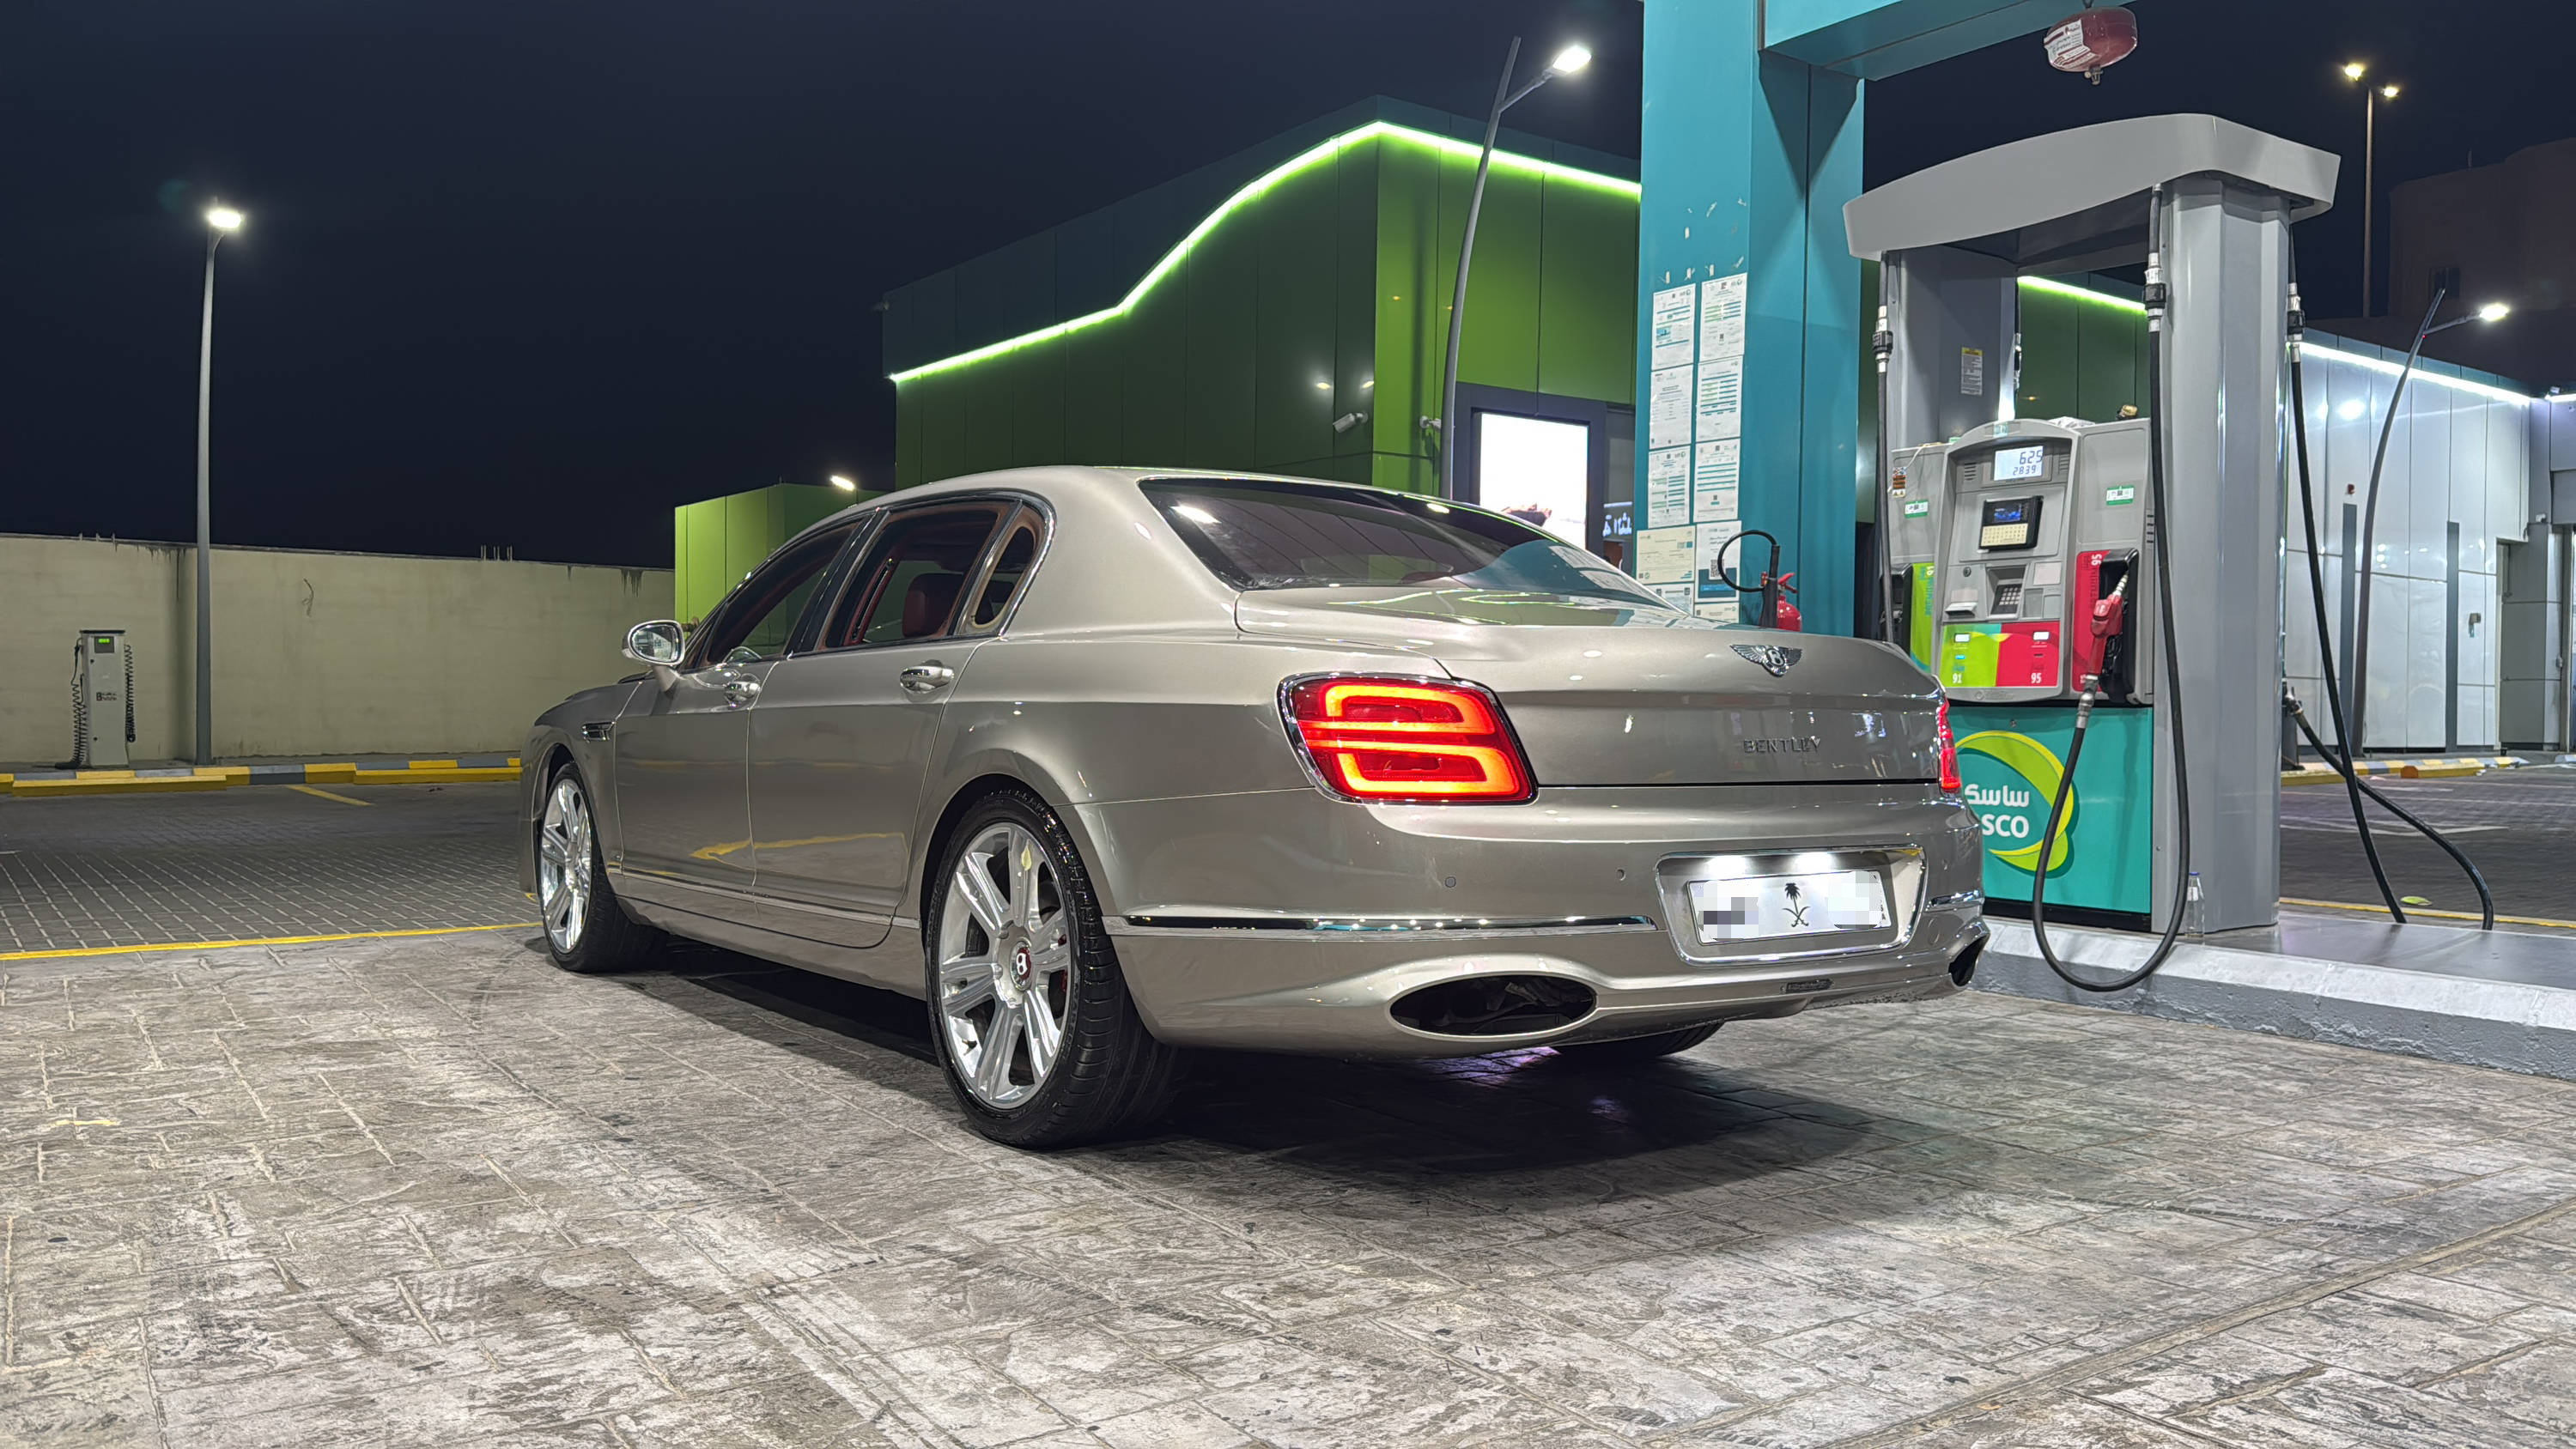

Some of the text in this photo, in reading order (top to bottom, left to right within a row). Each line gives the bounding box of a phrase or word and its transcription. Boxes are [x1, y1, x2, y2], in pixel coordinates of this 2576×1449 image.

[2092, 554, 2103, 566] 95
[1953, 673, 1962, 683] 91
[2031, 673, 2042, 683] 95
[1744, 736, 1820, 753] BENTLEY
[1965, 784, 2030, 807] ساسك
[1981, 814, 2030, 838] SCO
